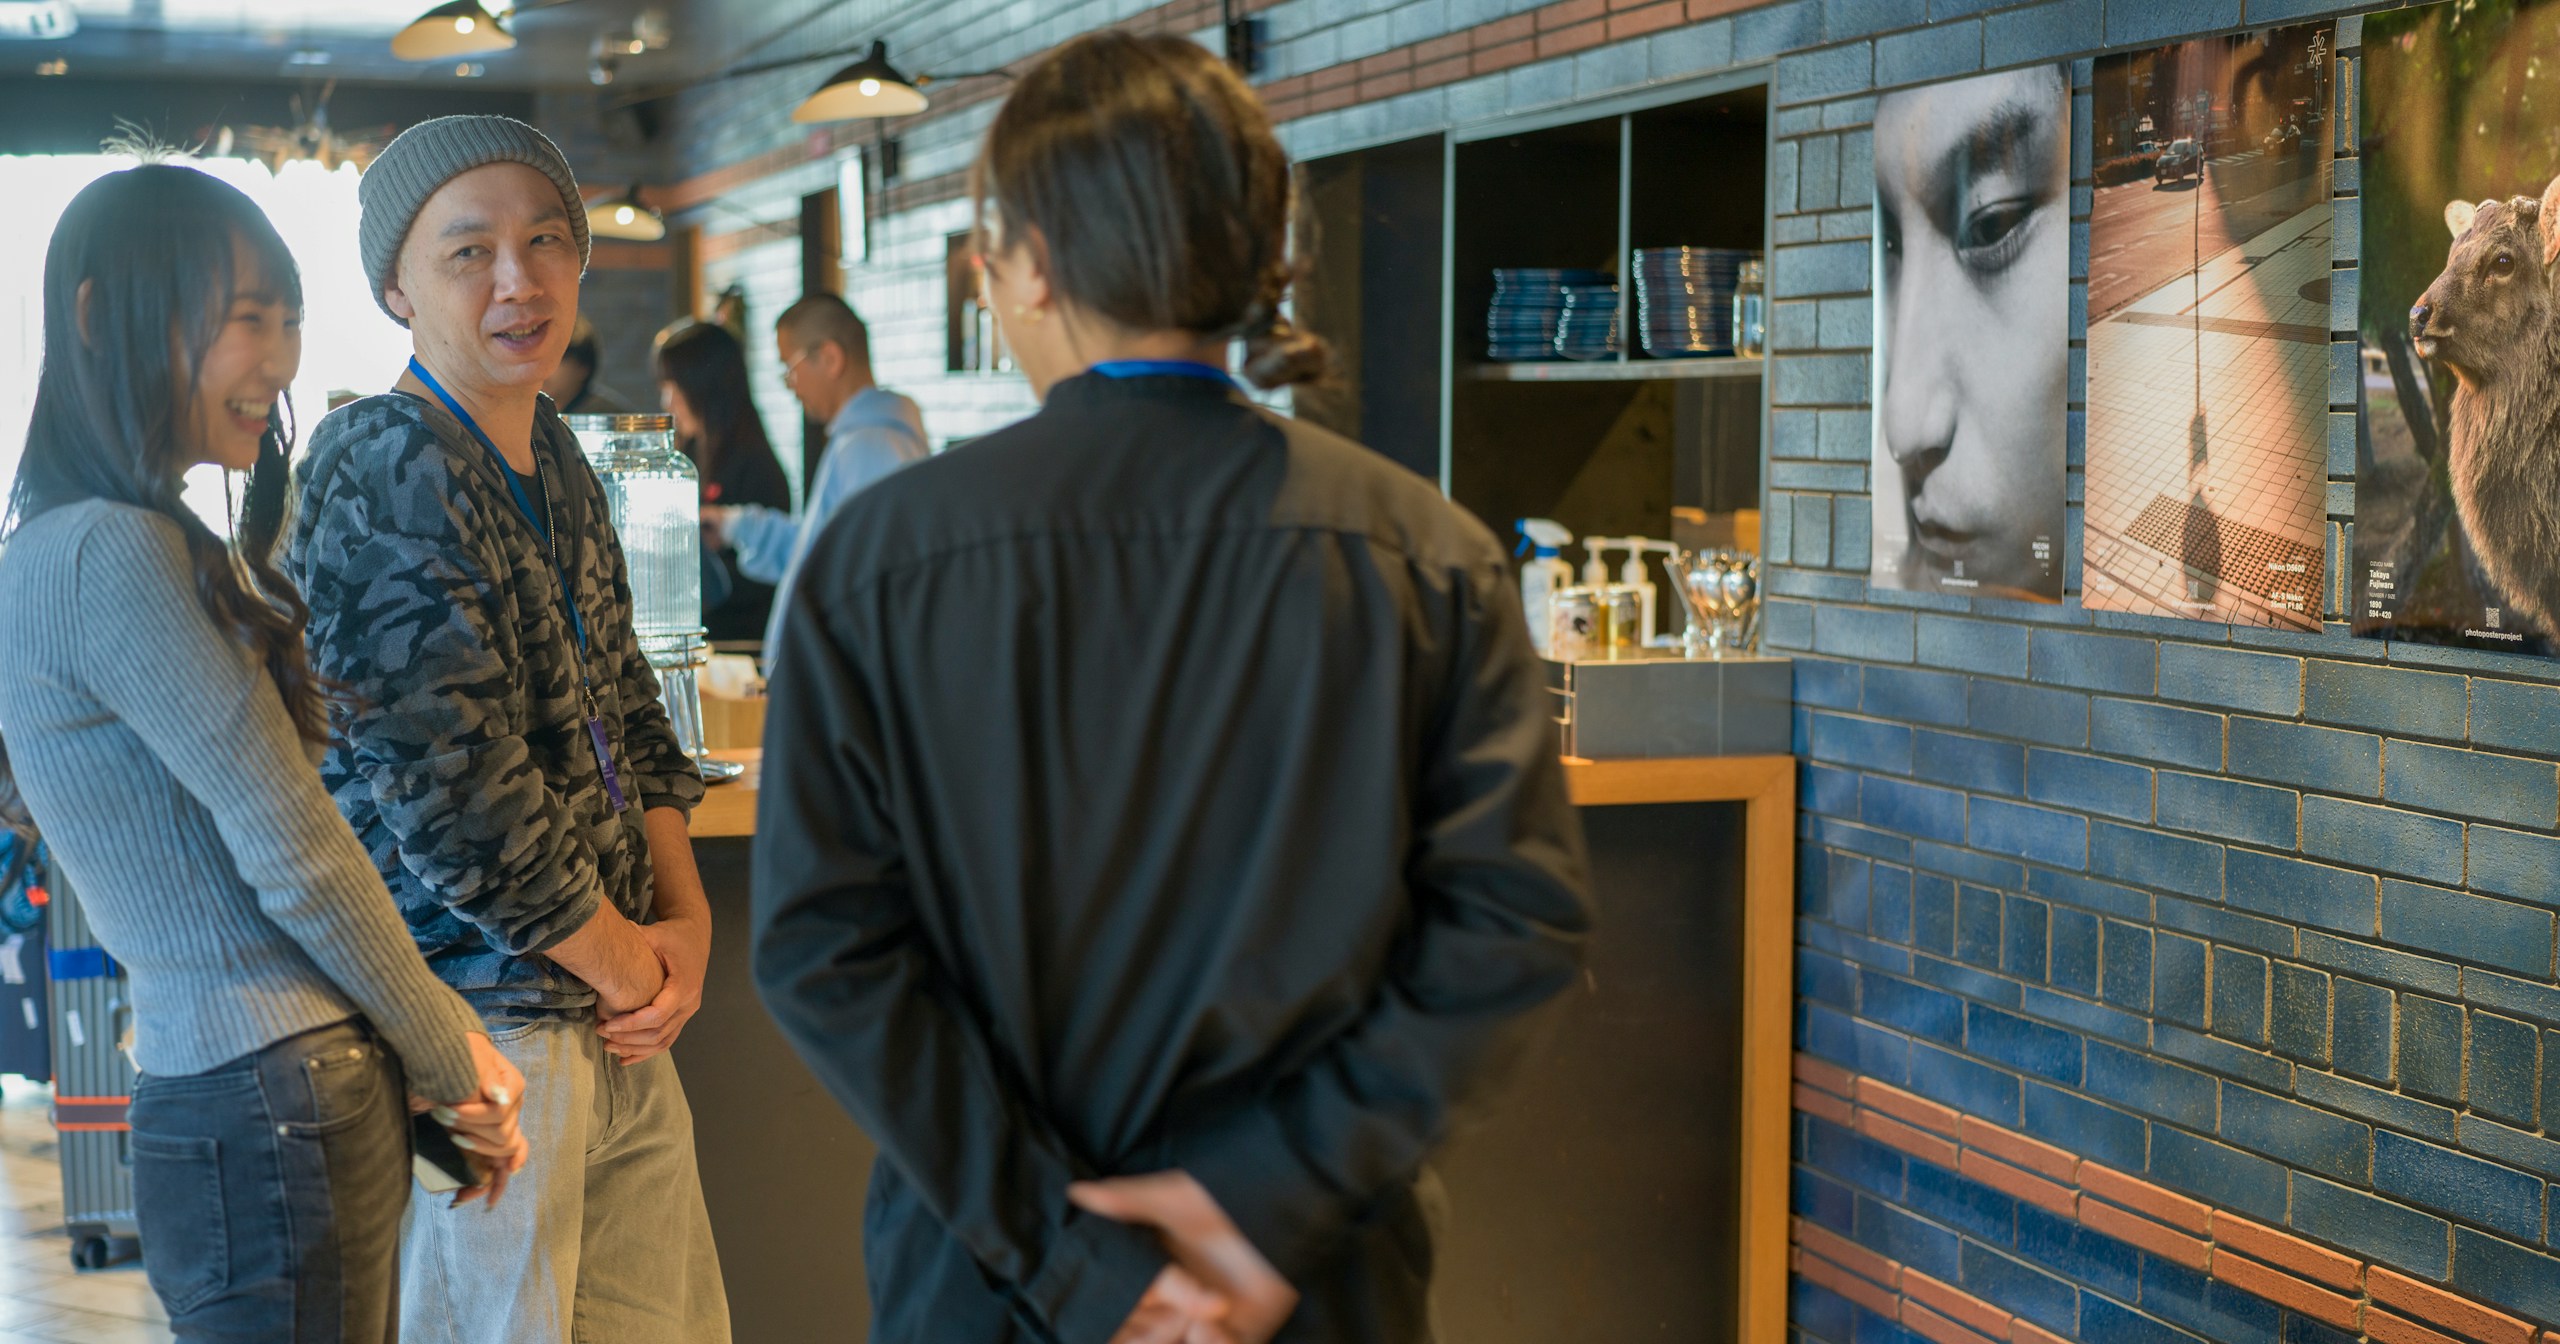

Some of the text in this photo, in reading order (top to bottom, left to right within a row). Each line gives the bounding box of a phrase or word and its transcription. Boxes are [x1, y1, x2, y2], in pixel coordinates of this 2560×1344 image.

[2268, 562, 2285, 571] Nikon
[2369, 570, 2390, 580] Takaya
[2369, 579, 2394, 589] Fujiwara
[2369, 600, 2382, 609] 1890
[2465, 628, 2523, 641] photoposterproject
